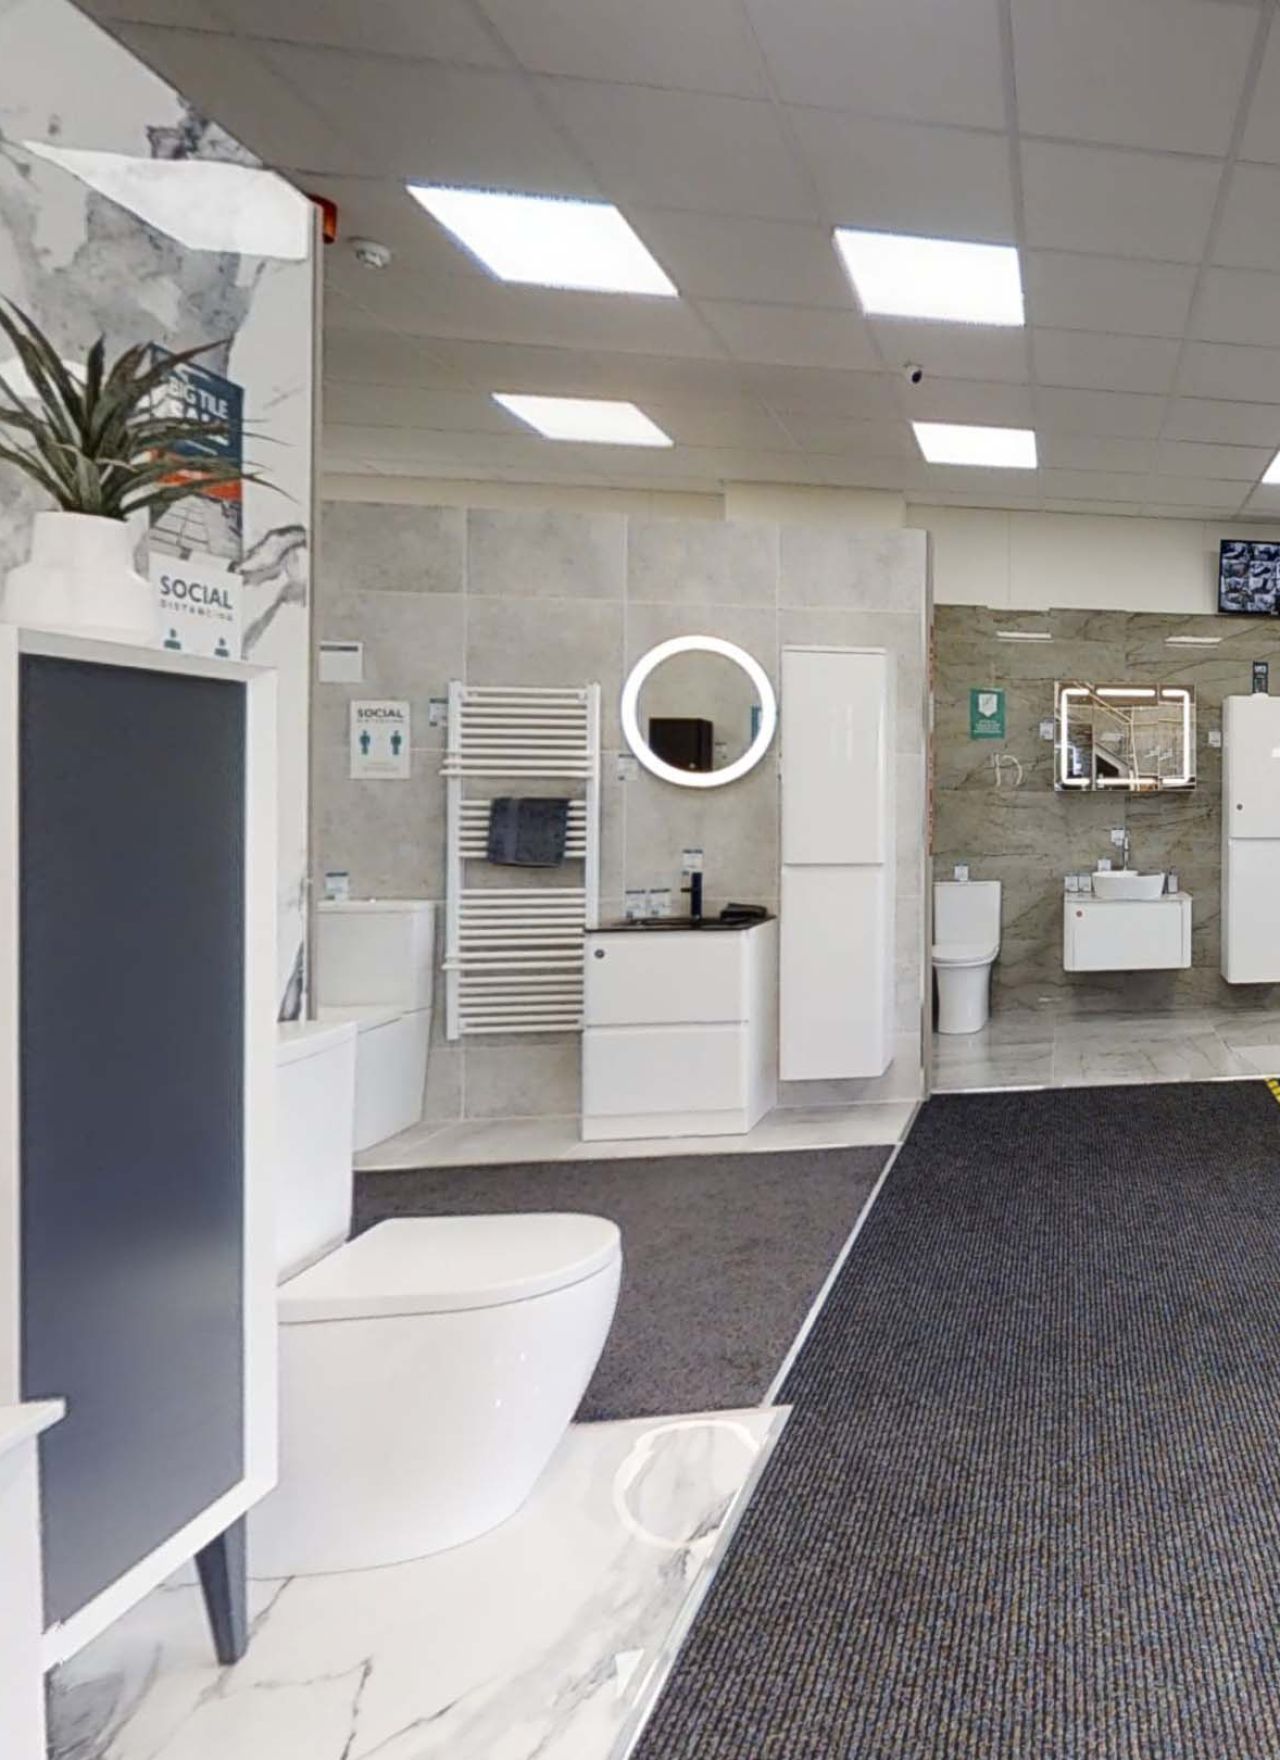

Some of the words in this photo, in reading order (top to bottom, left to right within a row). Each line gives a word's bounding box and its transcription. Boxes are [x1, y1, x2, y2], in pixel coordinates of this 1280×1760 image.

[198, 388, 228, 420] TILE
[160, 575, 233, 610] SOCIAL
[357, 708, 403, 718] SOCIAL
